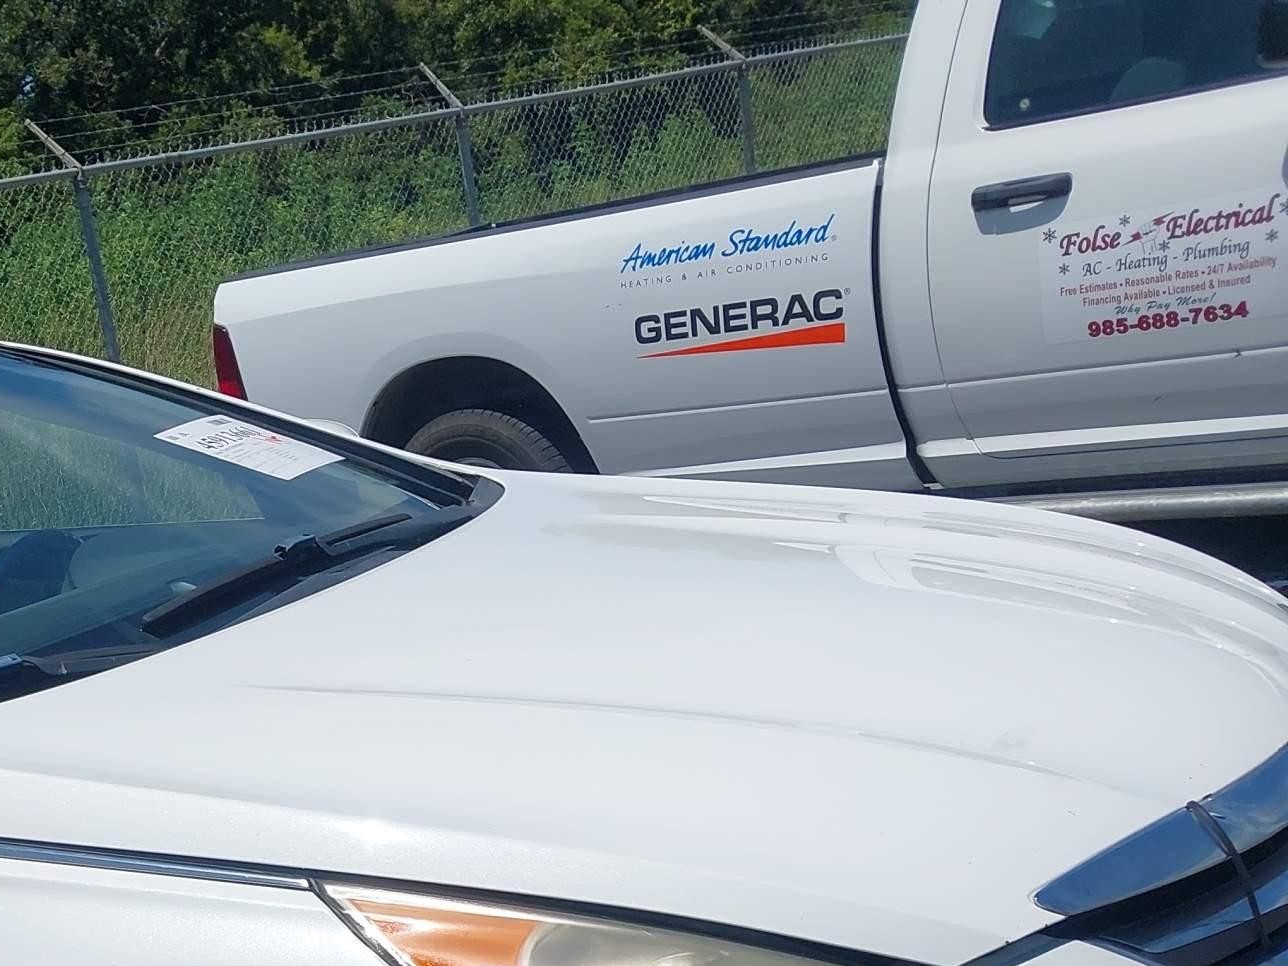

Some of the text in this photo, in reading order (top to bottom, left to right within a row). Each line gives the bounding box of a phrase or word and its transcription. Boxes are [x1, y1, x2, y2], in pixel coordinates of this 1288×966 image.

[620, 213, 835, 274] American Standard
[1060, 193, 1280, 256] Folse Electrical
[620, 253, 829, 289] HEATING & AIR CONDITIONING
[1060, 256, 1277, 296] Free Estimates Reasonable Rates 24/7 Availability
[1082, 261, 1103, 277] AC
[1115, 252, 1168, 272] Heating
[1182, 237, 1250, 261] Plumbing
[1082, 274, 1251, 308] Financing Available Licensed & Insured
[1114, 292, 1217, 315] Why Pay More!
[634, 288, 844, 345] GENERAC
[1087, 301, 1250, 338] 985-688-7634
